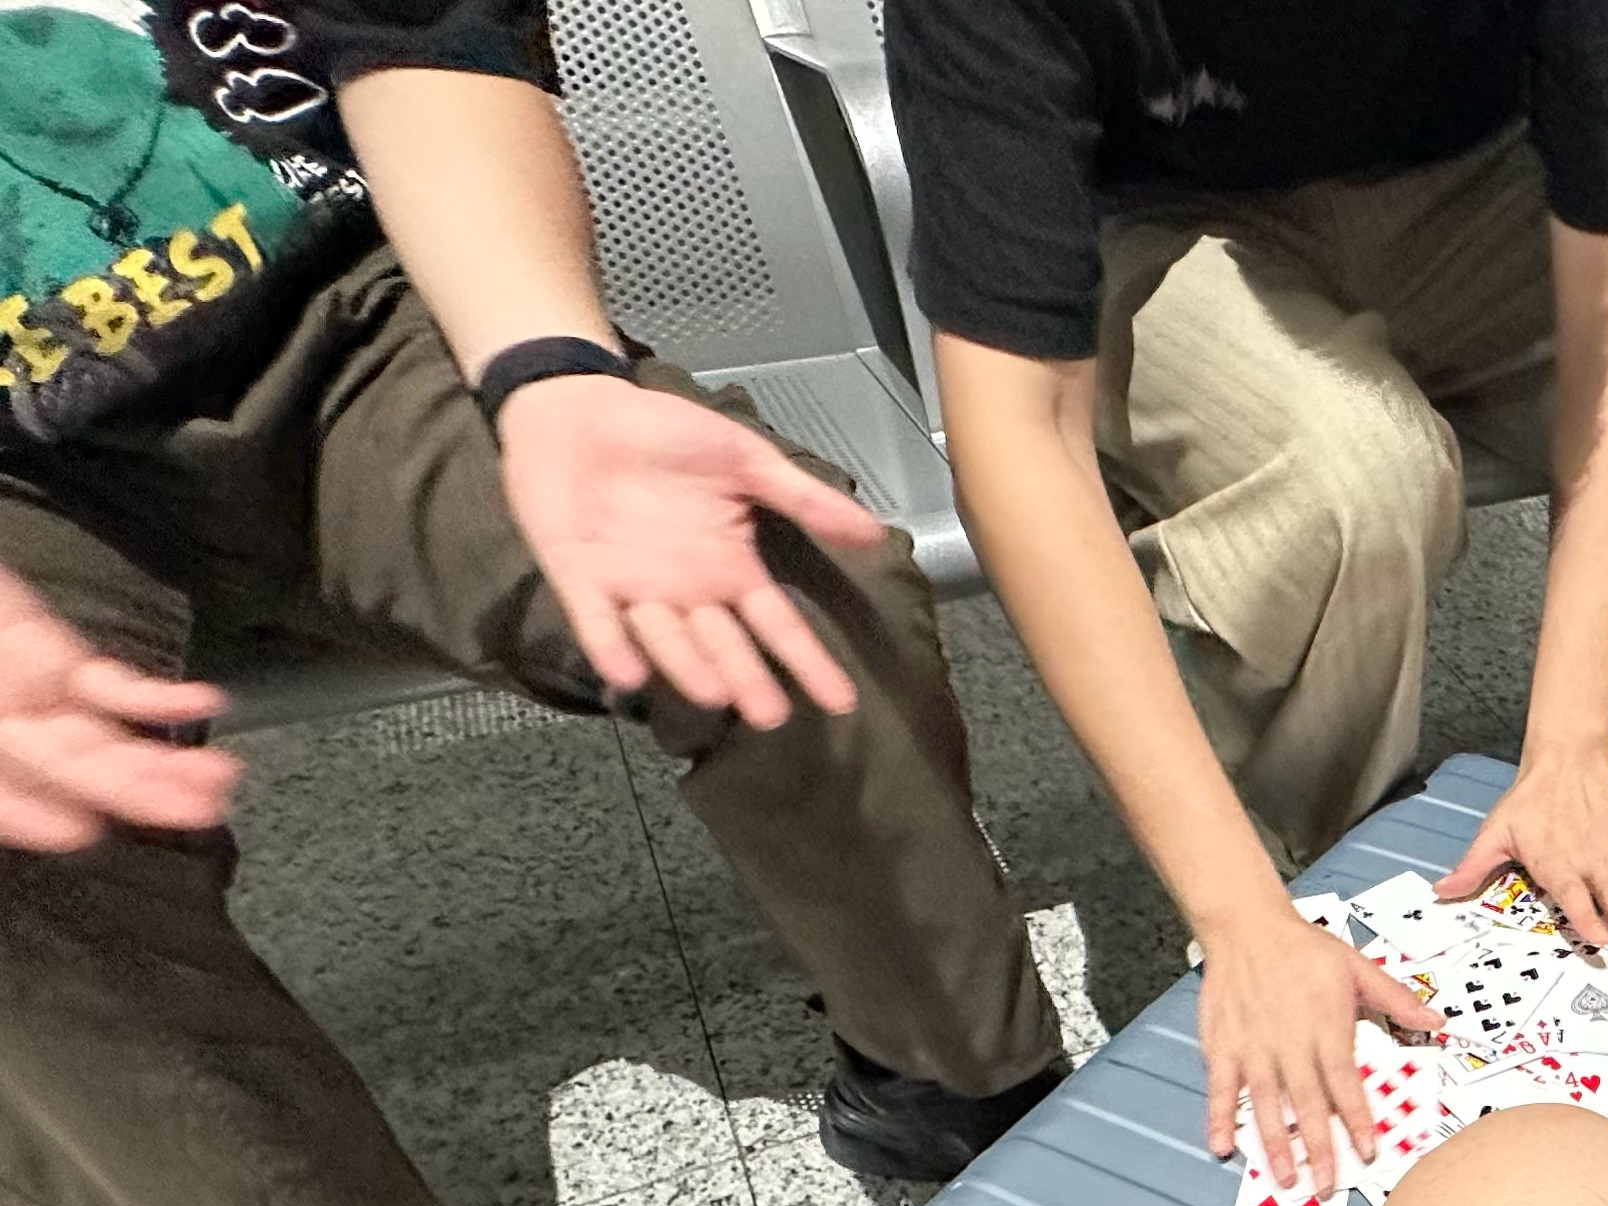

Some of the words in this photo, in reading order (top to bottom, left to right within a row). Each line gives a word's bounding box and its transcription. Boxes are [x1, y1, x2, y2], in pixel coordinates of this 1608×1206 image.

[0, 294, 70, 386] E
[61, 202, 264, 356] BEST
[1350, 902, 1366, 913] A
[1537, 1032, 1551, 1046] A
[1565, 1072, 1579, 1088] 4
